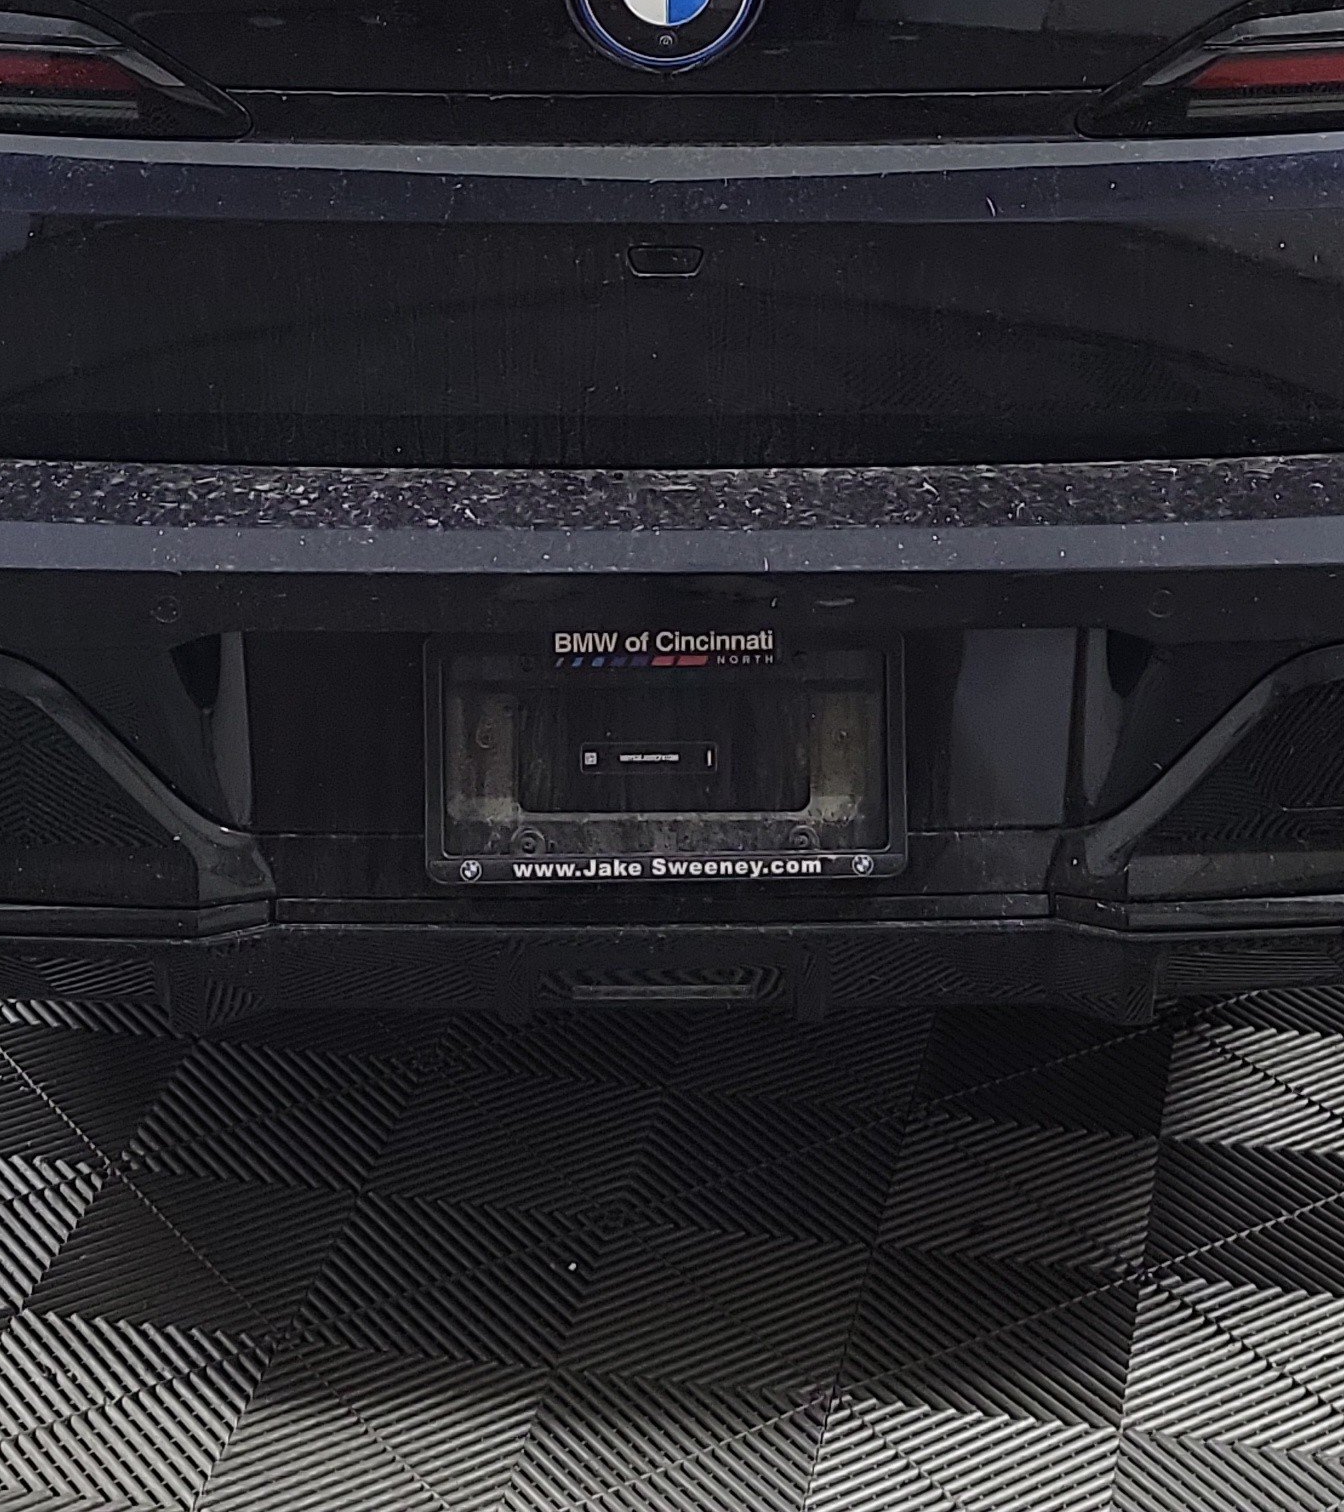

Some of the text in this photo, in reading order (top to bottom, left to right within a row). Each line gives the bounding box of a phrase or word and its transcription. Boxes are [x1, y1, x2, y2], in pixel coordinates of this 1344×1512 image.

[555, 630, 774, 653] BMW of Cincinnati
[716, 654, 774, 665] NORTH
[513, 857, 822, 879] www.Jake Sweeney.com
